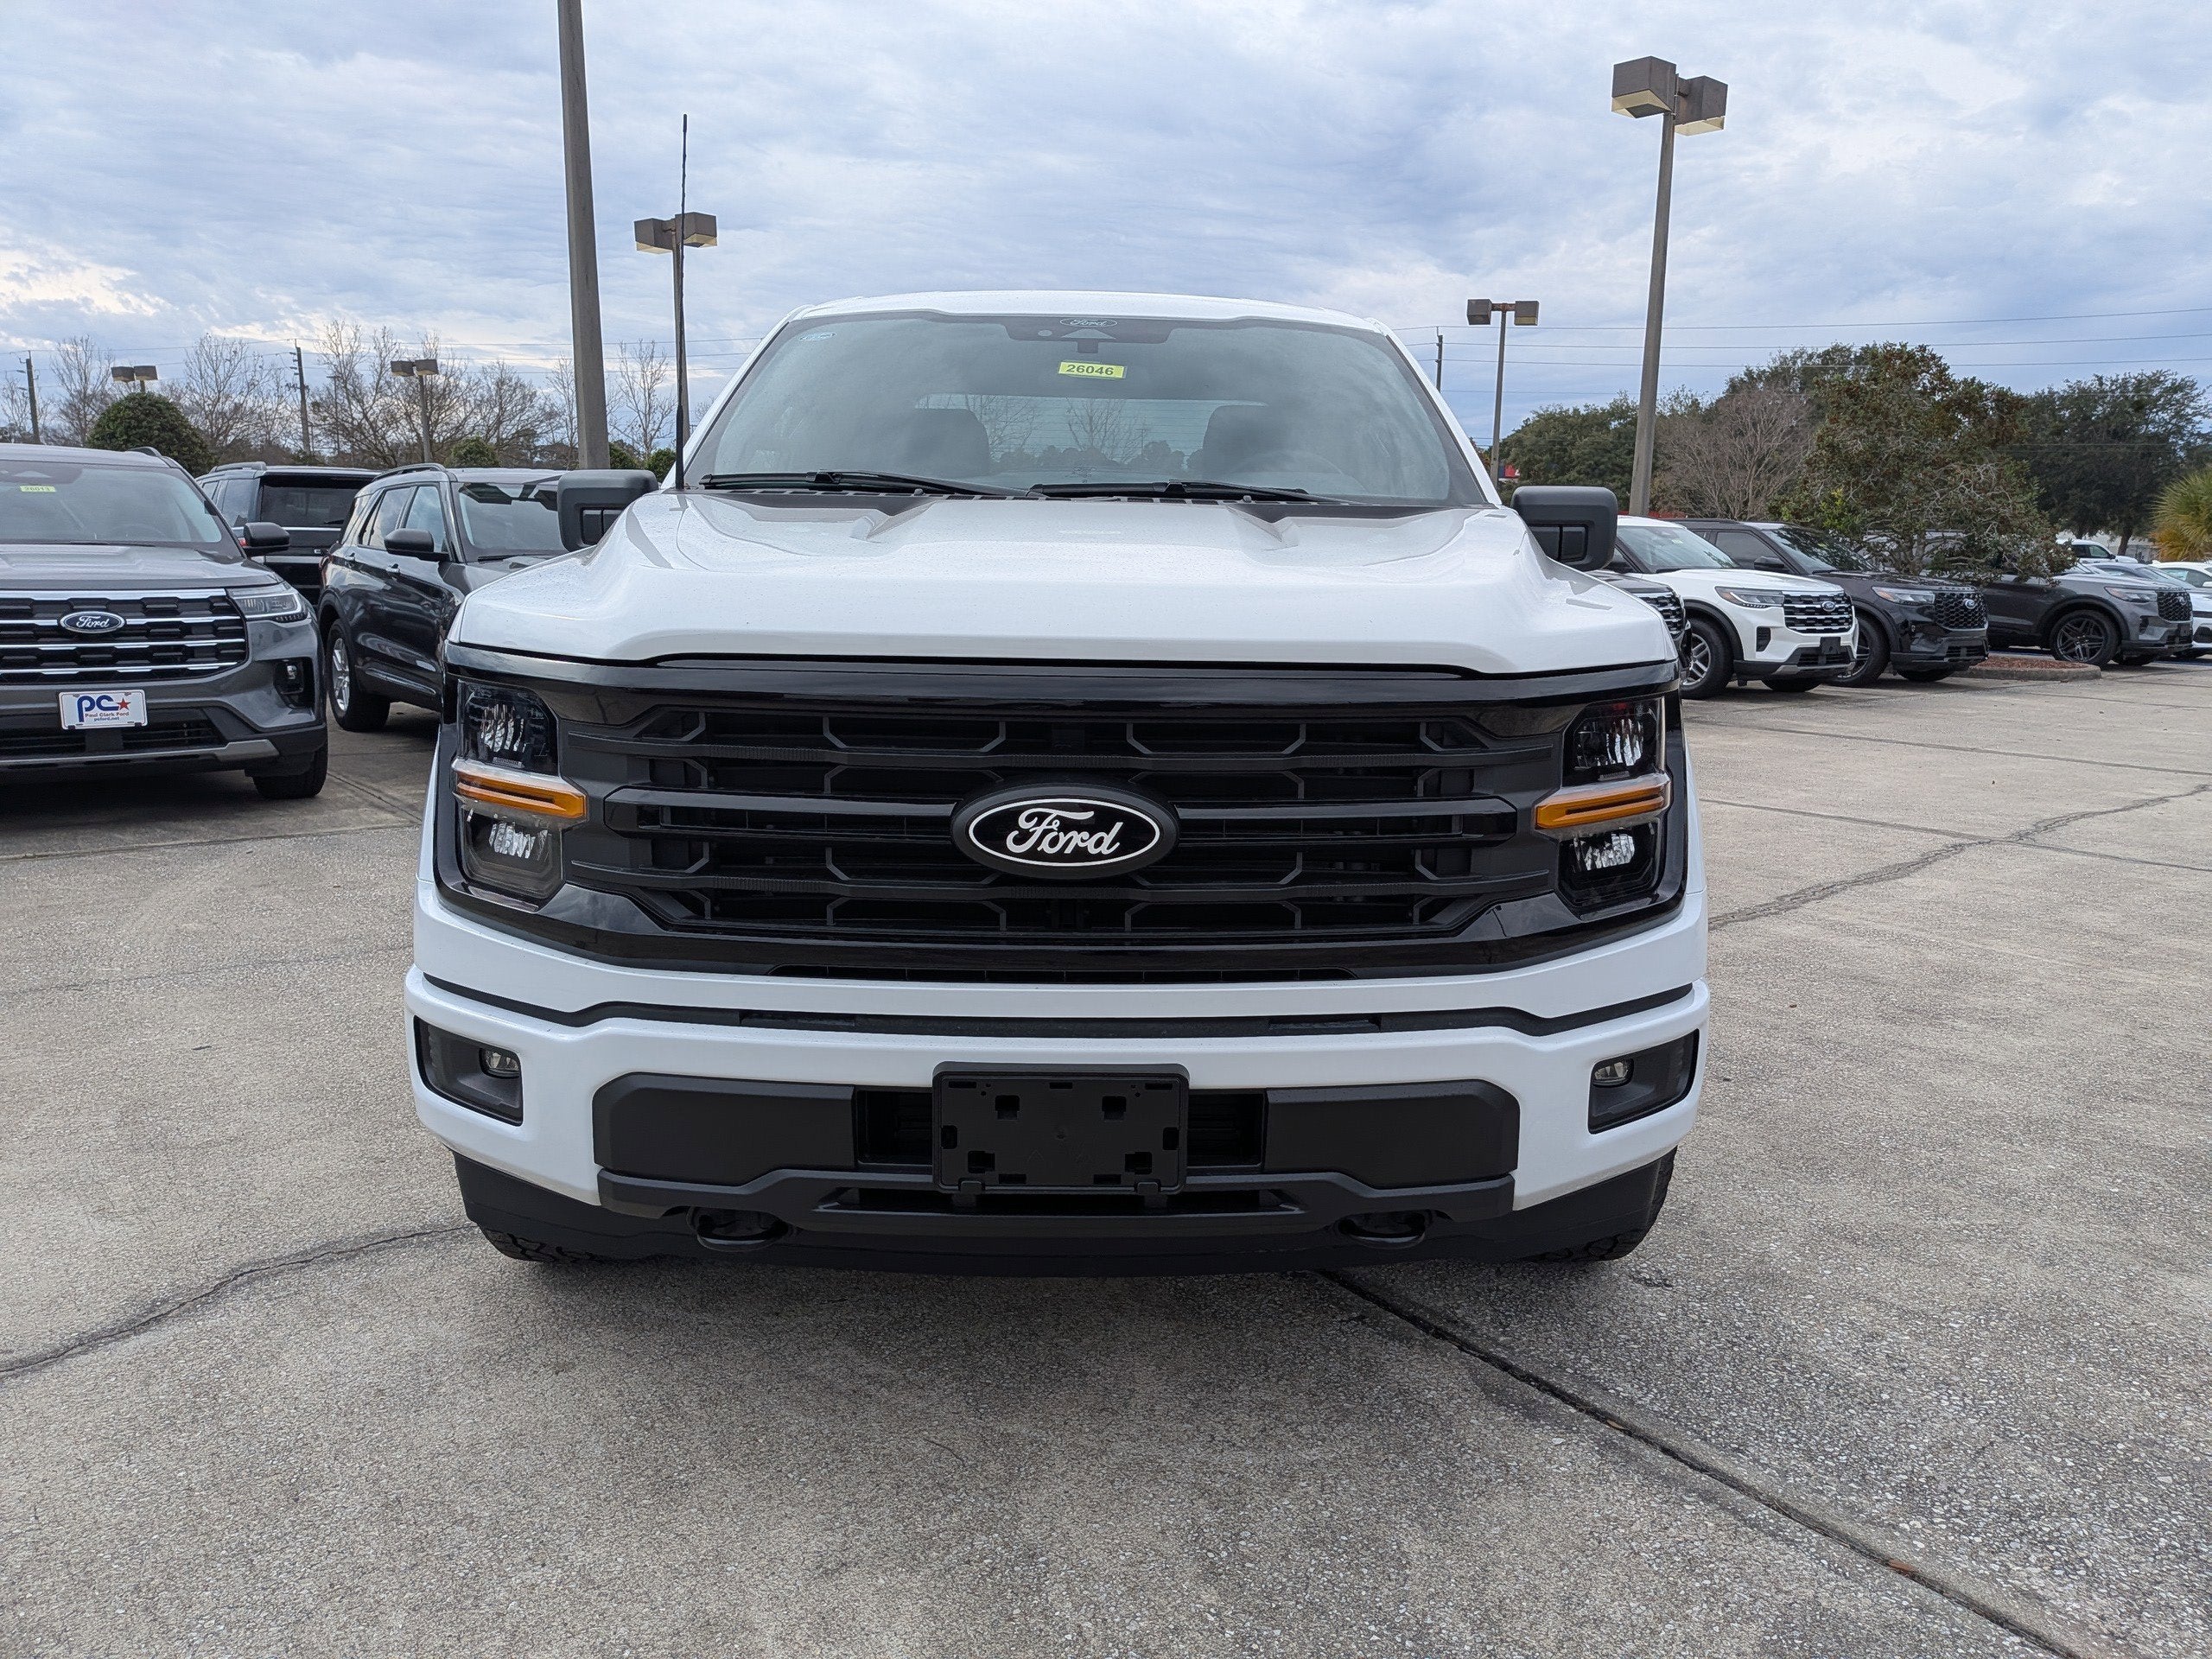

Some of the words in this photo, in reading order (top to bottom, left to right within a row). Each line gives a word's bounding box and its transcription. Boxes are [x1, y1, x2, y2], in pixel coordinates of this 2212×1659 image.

[1070, 318, 1108, 327] Ford
[1065, 364, 1114, 376] 26046
[76, 616, 110, 628] Ford
[1006, 807, 1123, 855] Ford
